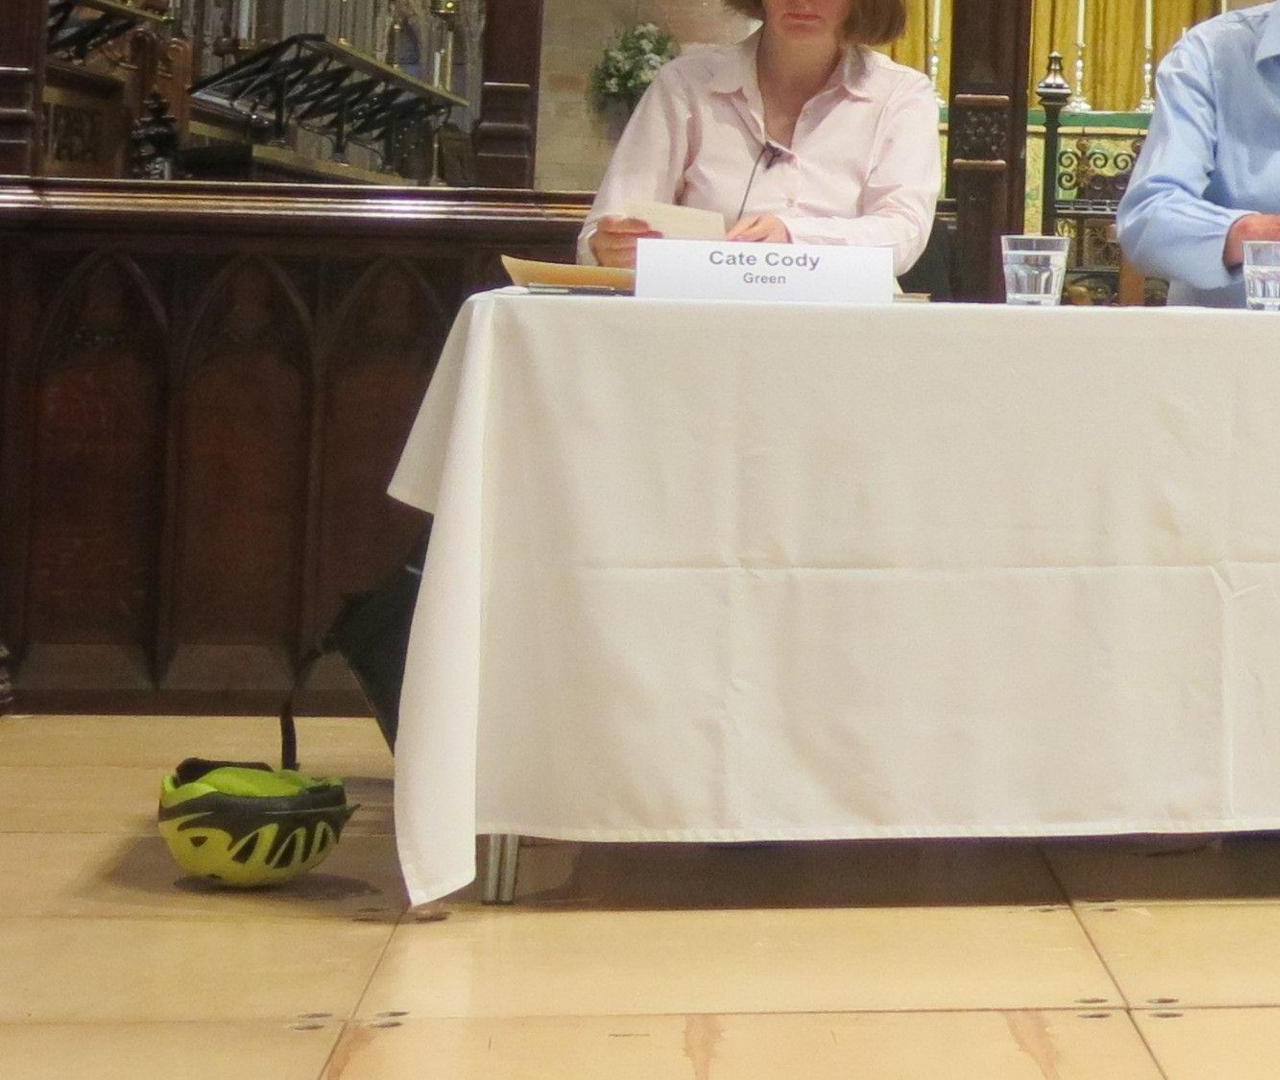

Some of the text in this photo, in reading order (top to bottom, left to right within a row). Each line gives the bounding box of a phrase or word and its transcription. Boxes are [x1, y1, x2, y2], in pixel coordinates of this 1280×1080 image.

[709, 250, 820, 271] Cate Cody
[743, 272, 787, 285] Green
